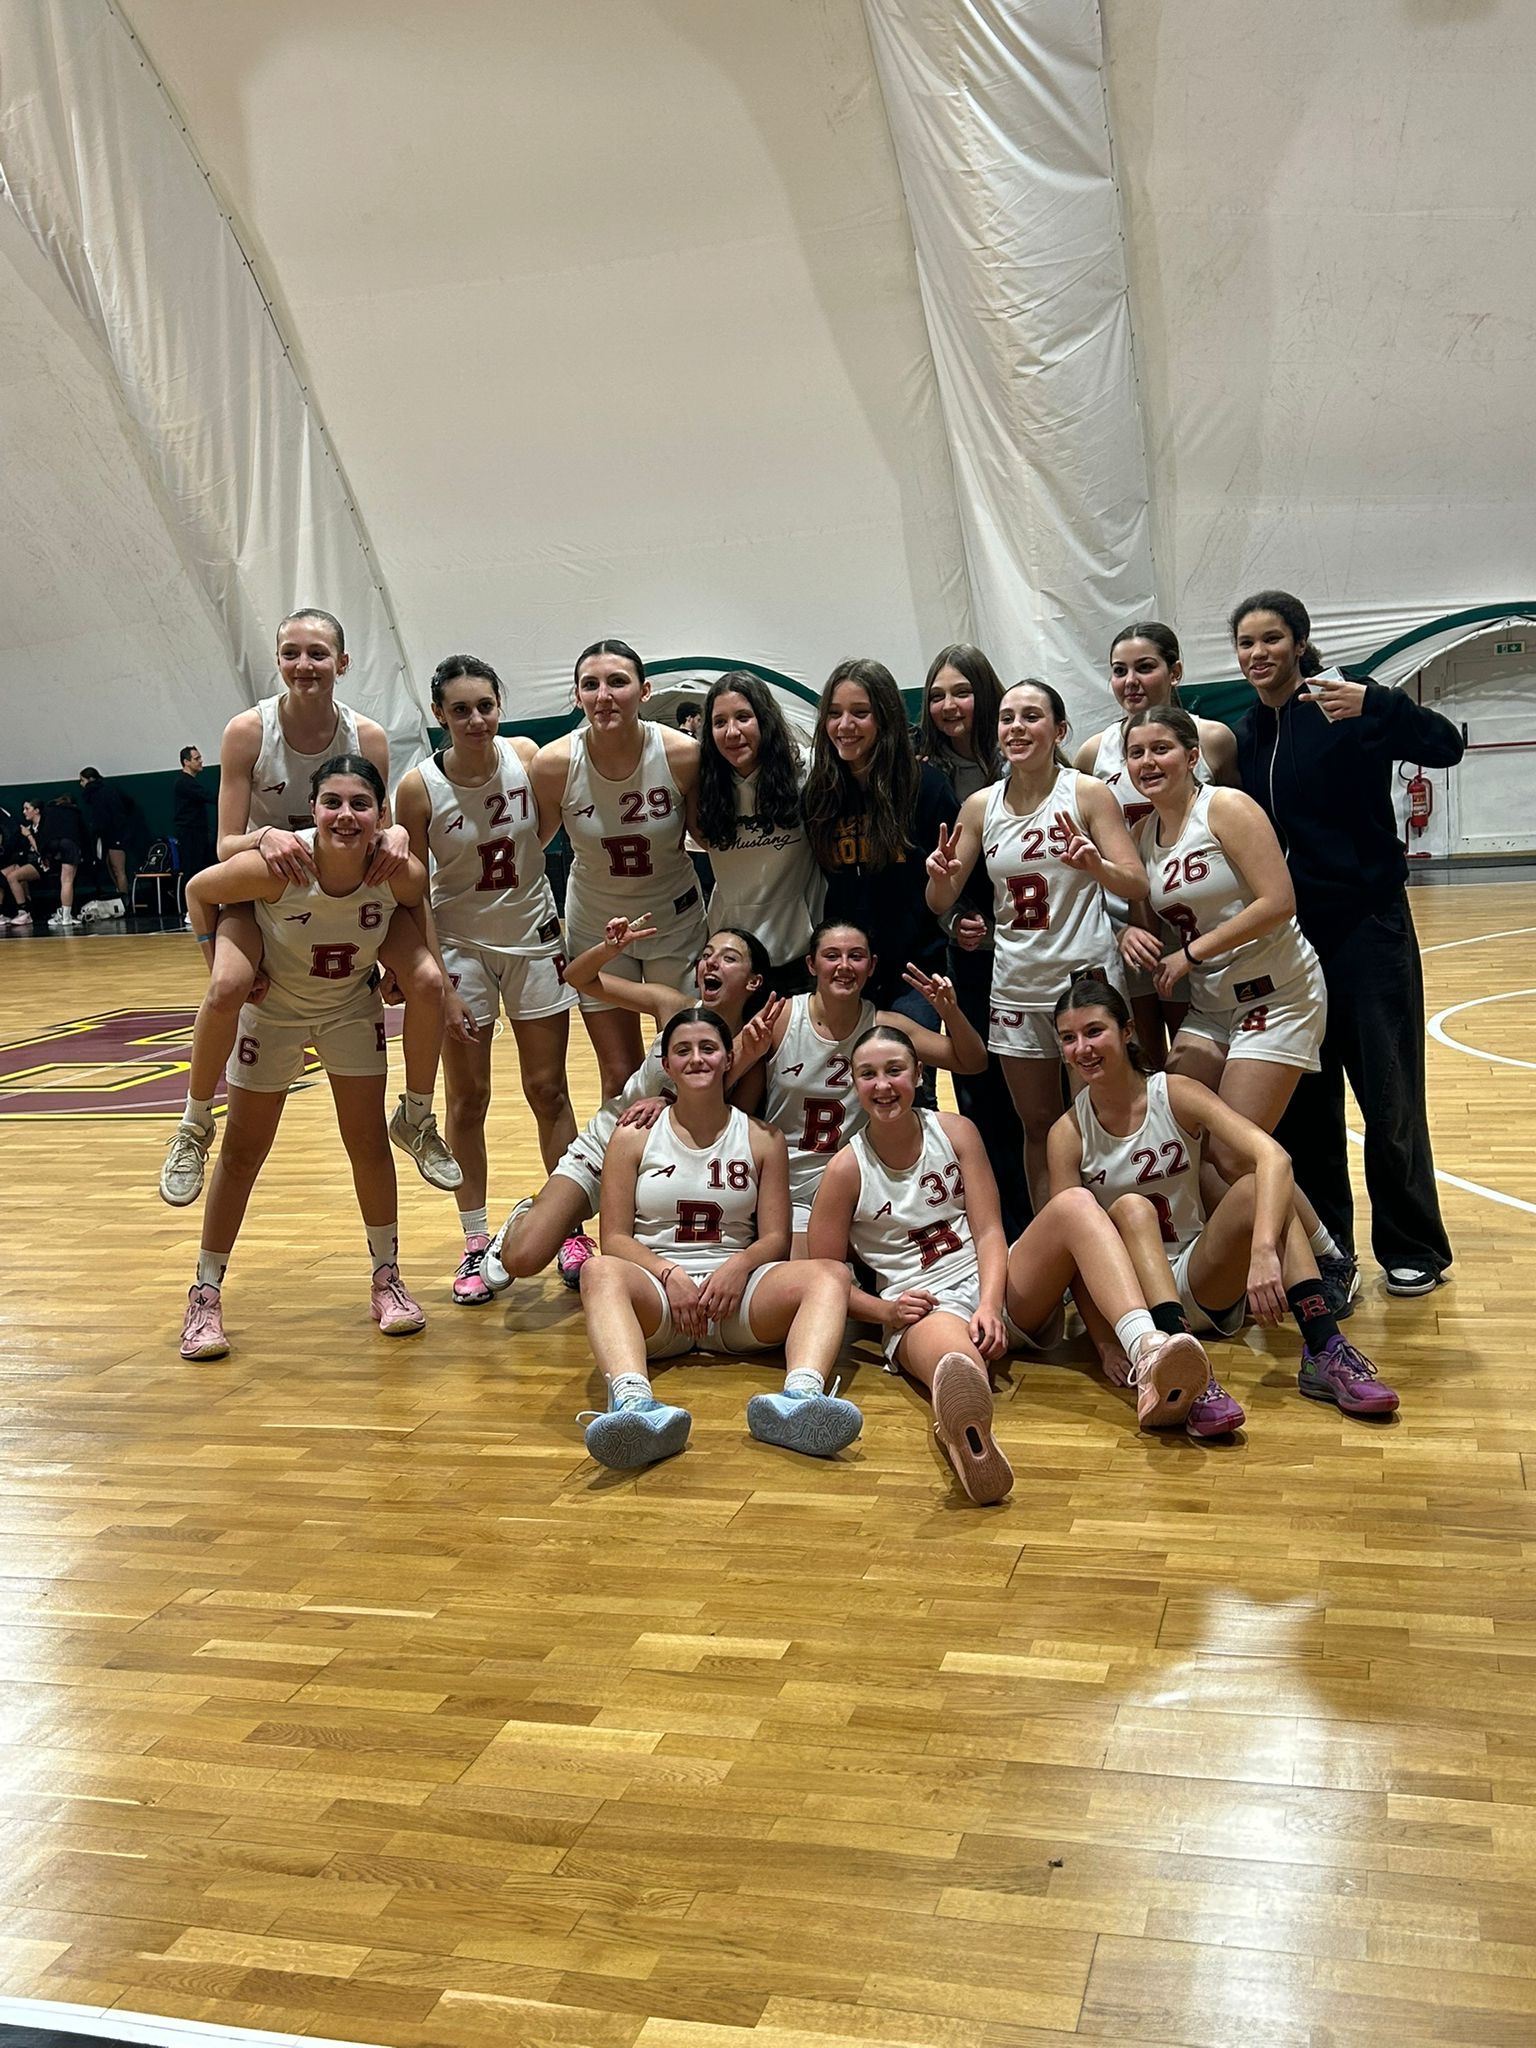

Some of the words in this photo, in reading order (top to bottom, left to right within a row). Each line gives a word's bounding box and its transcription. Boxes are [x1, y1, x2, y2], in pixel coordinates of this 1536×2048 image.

[484, 786, 529, 829] 27
[619, 785, 673, 824] 29
[475, 836, 519, 891] B
[601, 833, 653, 877] B
[1162, 850, 1211, 894] 26
[358, 901, 383, 930] 6
[1006, 873, 1050, 930] B
[237, 1034, 260, 1065] 6
[798, 1097, 846, 1153] B
[707, 1157, 750, 1191] 18
[919, 1161, 964, 1208] 32
[1130, 1139, 1191, 1186] 22
